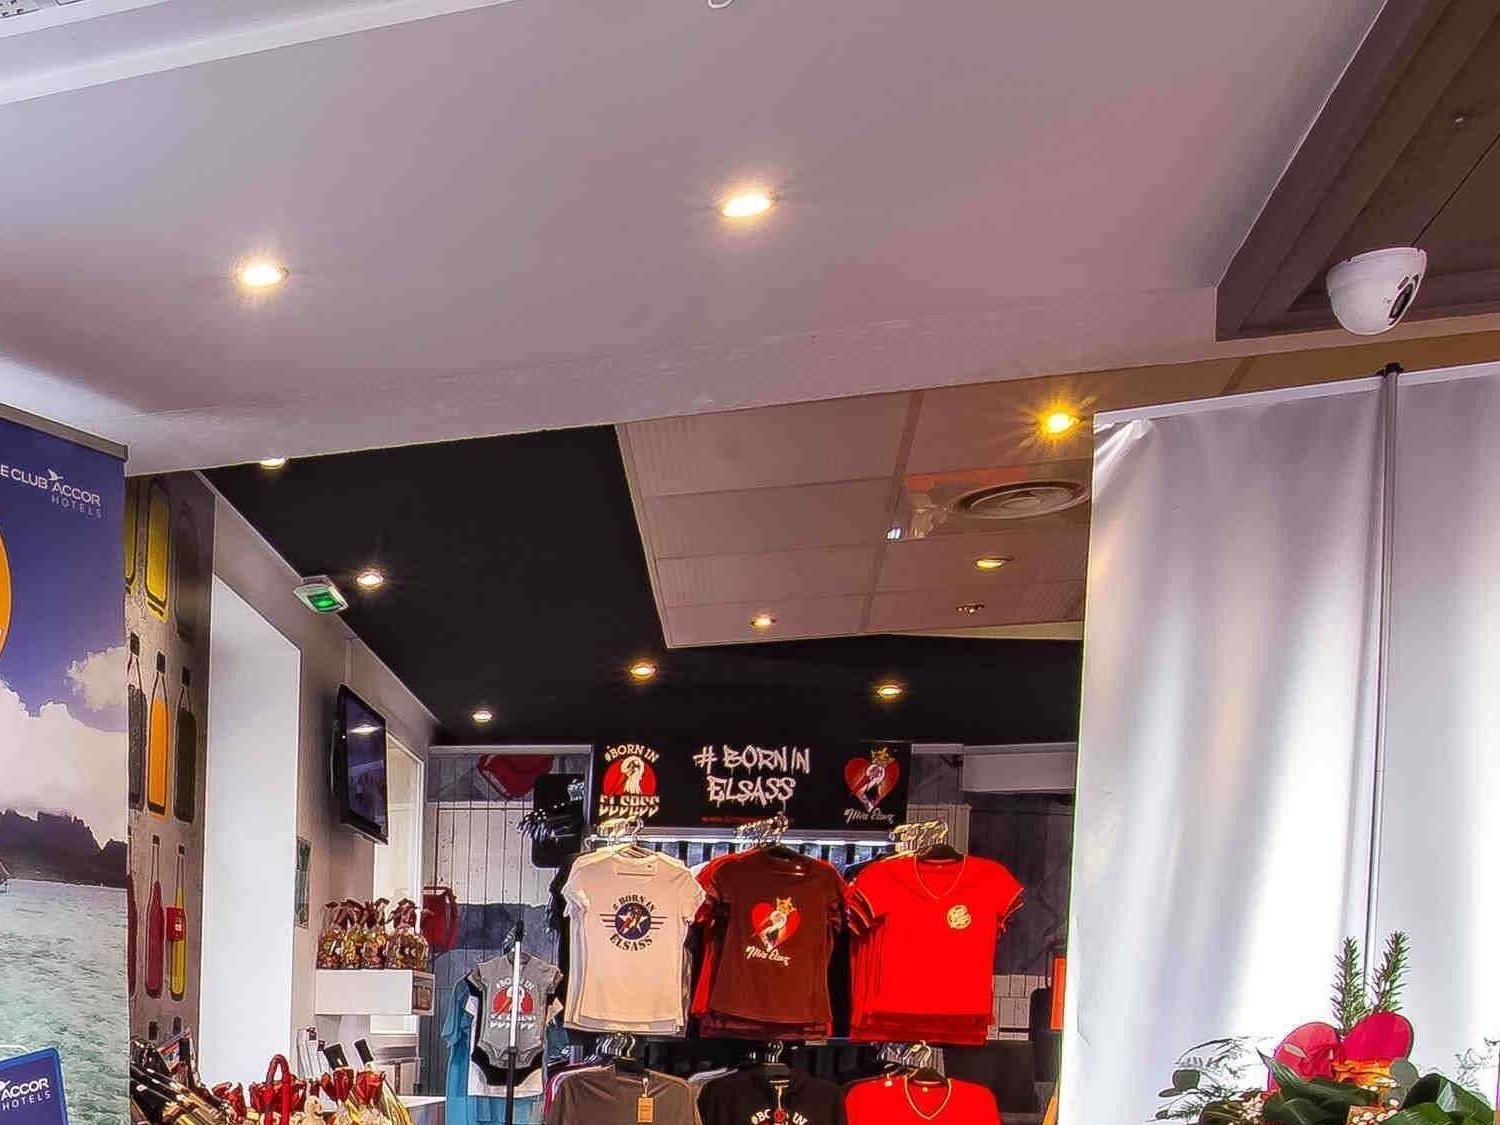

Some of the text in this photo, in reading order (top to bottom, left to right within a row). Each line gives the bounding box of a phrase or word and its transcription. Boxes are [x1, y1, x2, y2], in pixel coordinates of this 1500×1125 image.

[10, 468, 49, 490] CLUB
[51, 481, 101, 505] ACCOR
[51, 494, 102, 519] HOTELS
[644, 745, 659, 763] IN
[723, 745, 787, 772] BORN
[791, 747, 810, 774] IN
[707, 776, 796, 805] ELSASS
[609, 933, 654, 952] ELSASS
[0, 1078, 49, 1101] ACCOR
[2, 1090, 51, 1111] HOTELS
